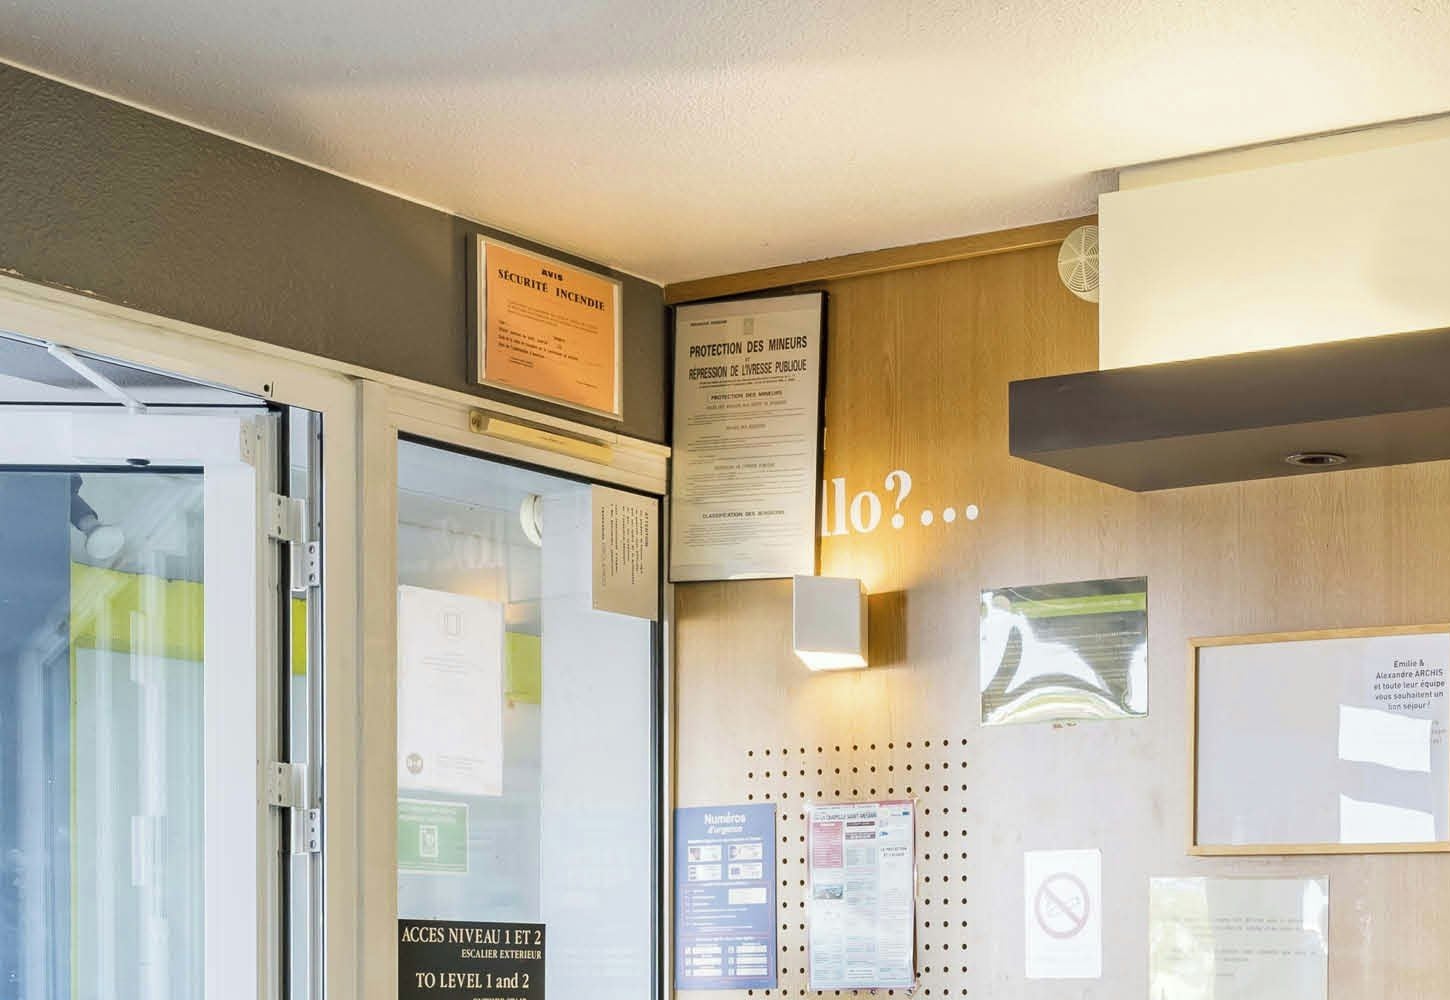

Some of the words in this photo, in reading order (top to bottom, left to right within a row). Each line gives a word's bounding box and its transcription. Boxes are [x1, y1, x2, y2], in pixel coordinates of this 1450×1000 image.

[498, 268, 548, 292] SÉCURITÉ
[556, 288, 605, 312] INCENDIE
[690, 342, 742, 358] PROTECTION
[746, 340, 764, 353] DES
[768, 336, 807, 351] MINEURS
[730, 365, 738, 376] DE
[742, 362, 772, 376] L'IVRESSE
[775, 359, 807, 373] PUBLIQUE
[1376, 670, 1413, 679] Alexandre
[1415, 669, 1443, 677] ARCHIS
[1420, 680, 1445, 688] équipe
[1394, 691, 1432, 700] souhaitent
[704, 811, 746, 824] Numéros
[402, 927, 444, 942] ACCES
[448, 928, 500, 944] NIVEAU
[505, 930, 511, 944] 1
[515, 930, 531, 944] ET
[534, 930, 542, 944] 2
[461, 949, 498, 959] ESCALIER
[500, 950, 542, 959] EXTERIEUR
[415, 972, 436, 988] TO
[440, 973, 482, 988] LEVEL
[486, 974, 492, 988] 1
[496, 972, 518, 988] and
[522, 973, 529, 988] 2
